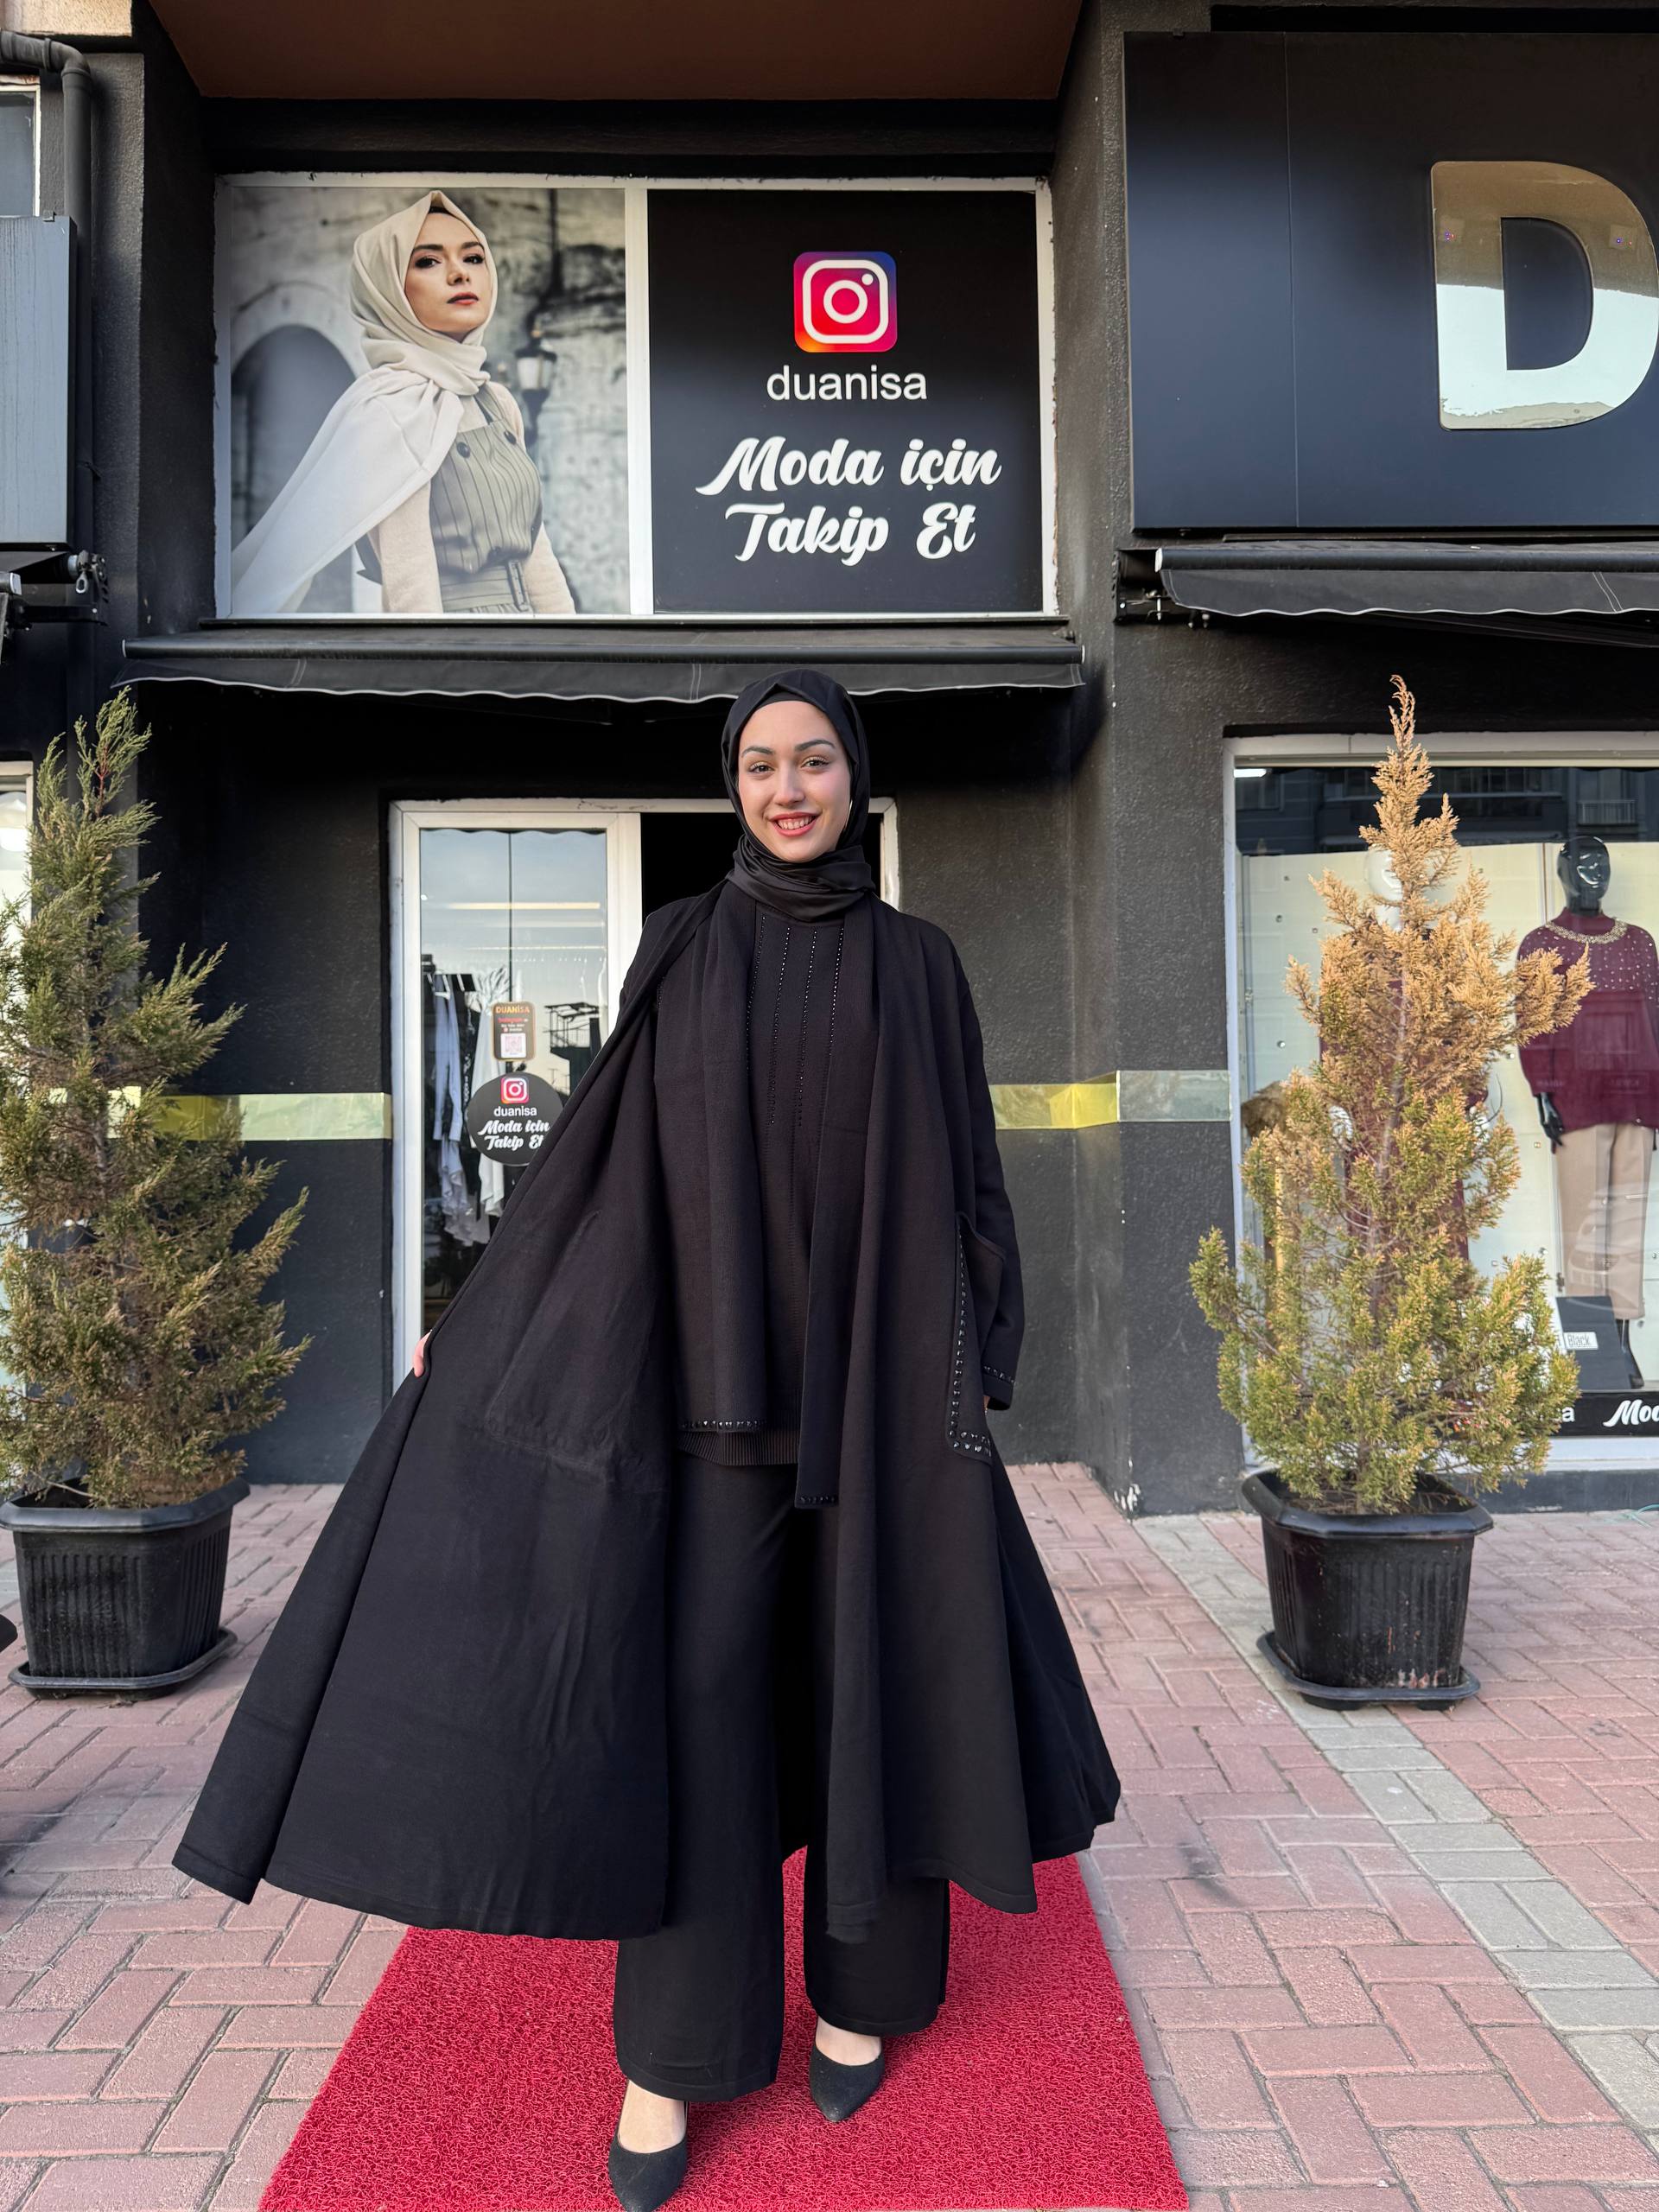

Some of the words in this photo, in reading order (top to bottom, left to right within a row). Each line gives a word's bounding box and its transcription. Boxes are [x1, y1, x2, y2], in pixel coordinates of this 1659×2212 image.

[1431, 161, 1659, 429] D
[766, 365, 927, 400] duanisa
[695, 435, 884, 496] Moda
[899, 438, 1002, 492] için
[724, 502, 889, 567] Takip
[916, 502, 976, 560] Et
[477, 1120, 523, 1136] Moda
[524, 1120, 550, 1134] için
[493, 1106, 537, 1117] duanisa
[484, 1135, 524, 1152] Takip
